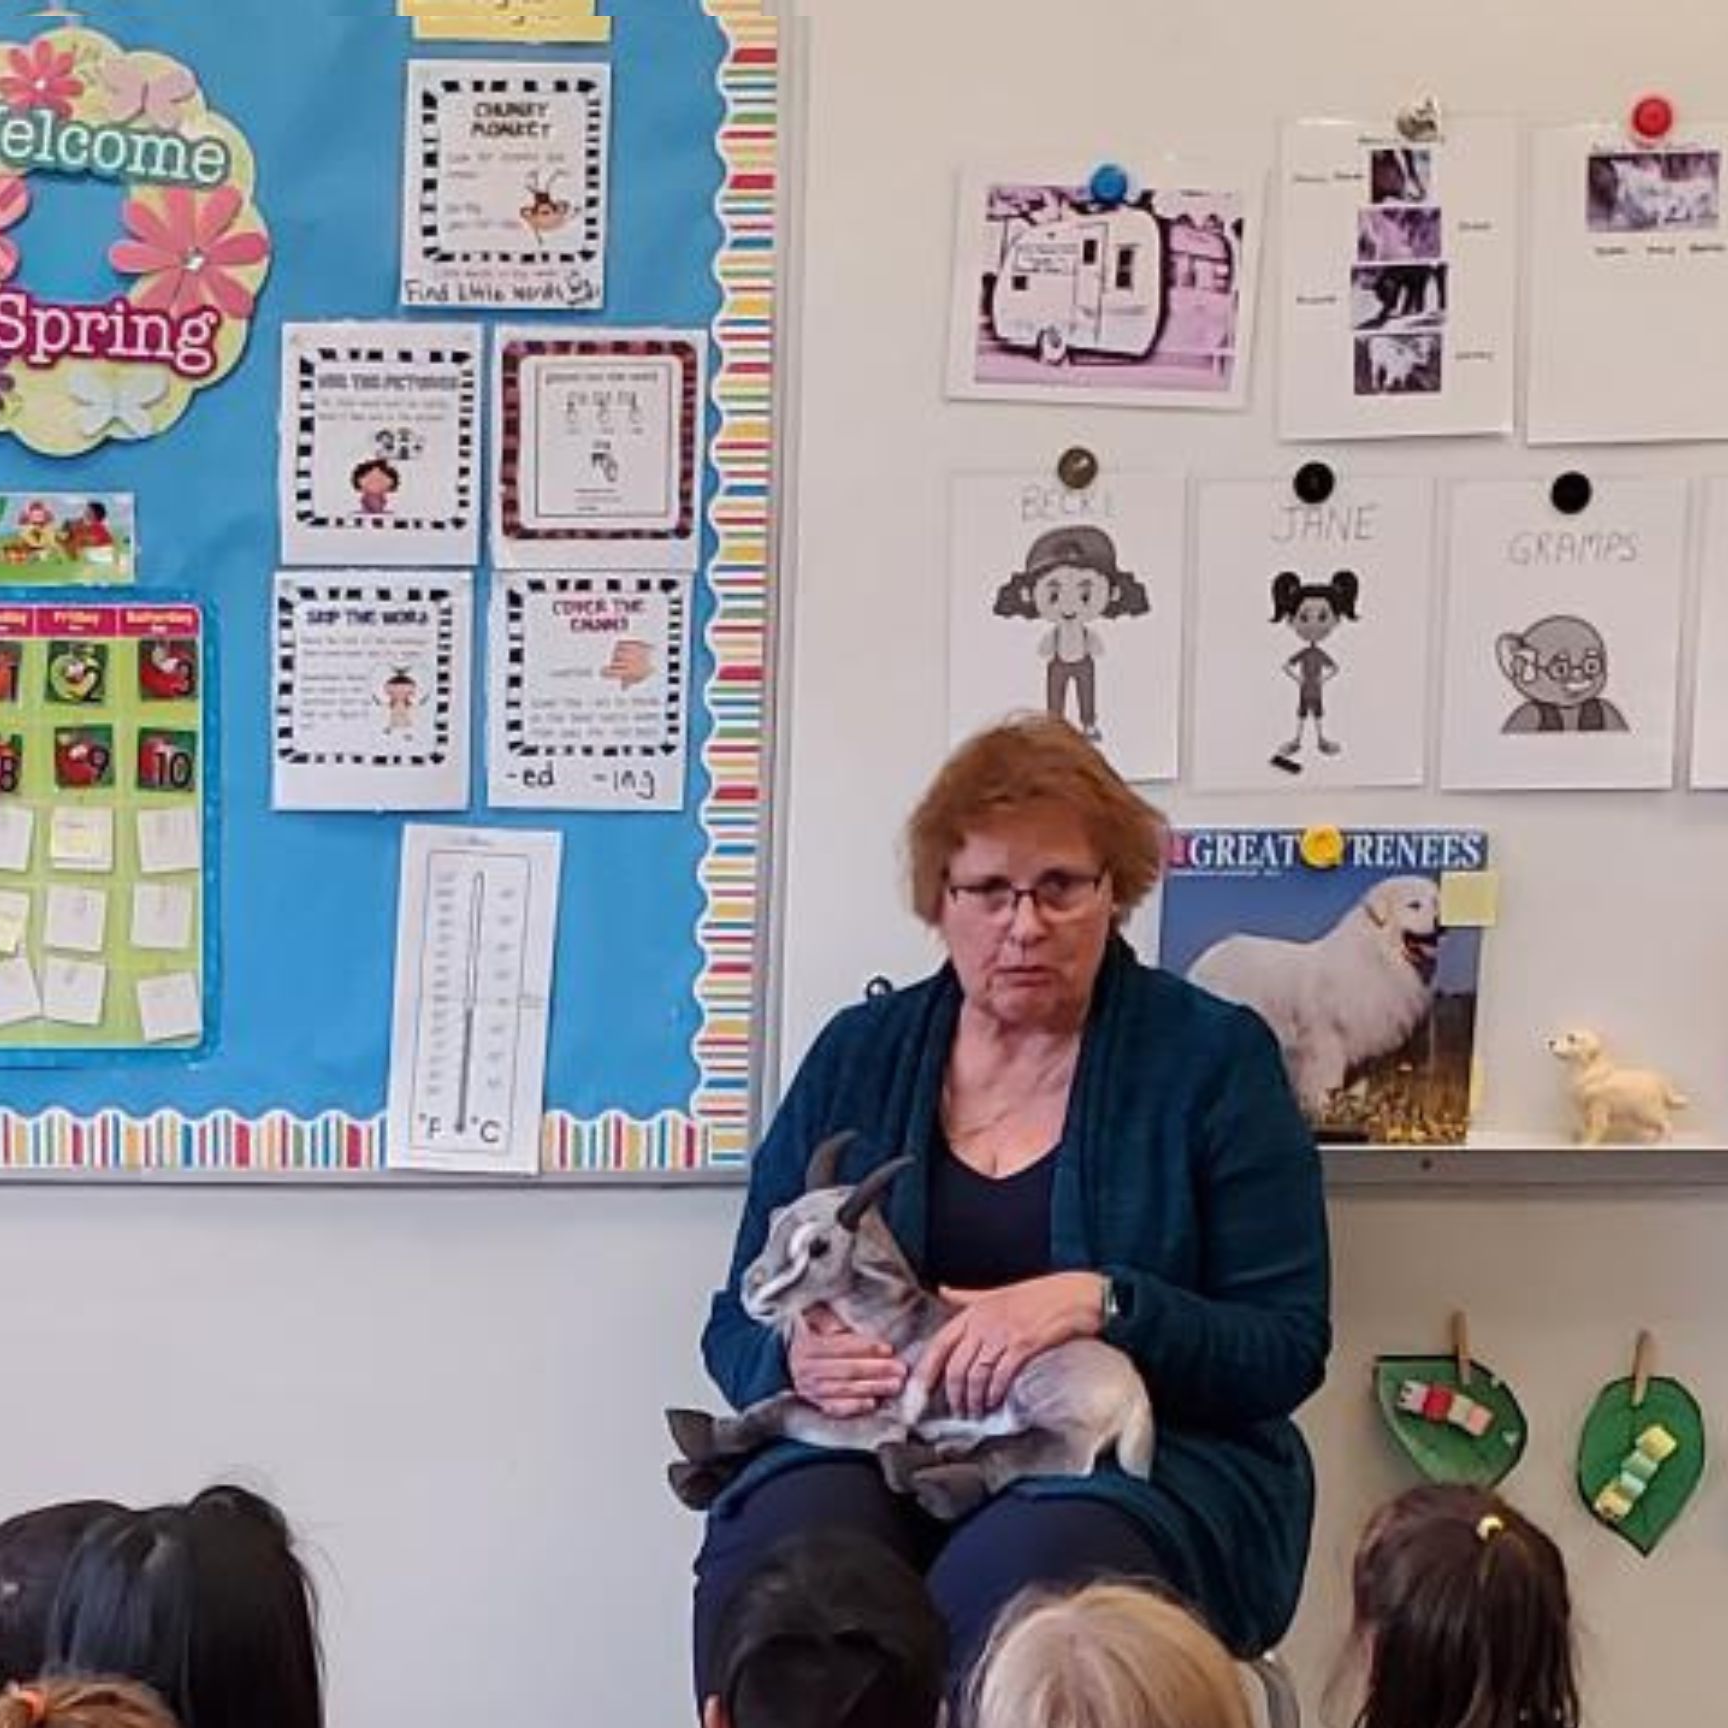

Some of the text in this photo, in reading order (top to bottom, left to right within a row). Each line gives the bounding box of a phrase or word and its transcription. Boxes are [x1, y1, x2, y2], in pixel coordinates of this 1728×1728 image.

[1273, 505, 1376, 542] JANE
[1509, 530, 1637, 565] GRAMPS
[77, 666, 103, 703] 2
[175, 664, 194, 695] 3
[0, 755, 18, 790] 8
[89, 745, 109, 781] 9
[154, 751, 190, 787] 10
[1190, 834, 1483, 868] GREAT RENEES
